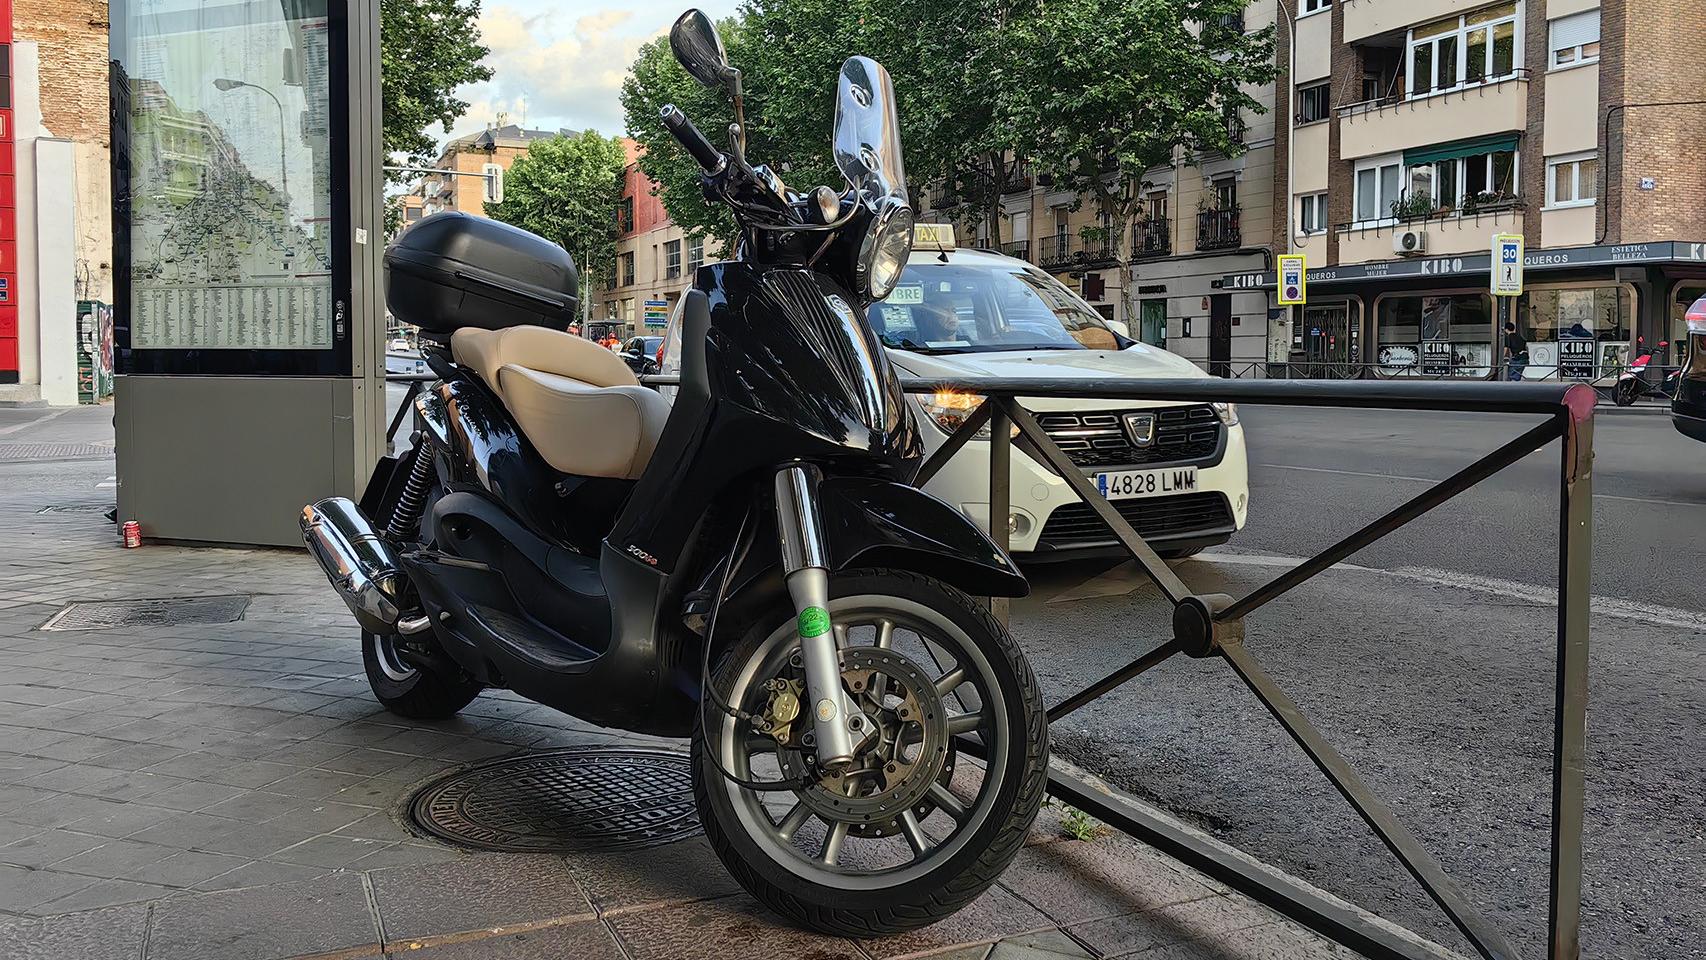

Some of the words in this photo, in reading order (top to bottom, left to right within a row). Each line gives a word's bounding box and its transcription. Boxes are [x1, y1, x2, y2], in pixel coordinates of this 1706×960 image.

[915, 228, 938, 241] TAXI
[1503, 249, 1516, 259] 30
[1524, 254, 1569, 265] QUEROS
[1612, 252, 1646, 260] BELLEZA
[1364, 263, 1389, 271] HOMBRE
[1421, 258, 1462, 274] KIBO
[1233, 274, 1263, 288] KIBO
[1306, 271, 1336, 281] QUEROS
[892, 288, 920, 299] BRE
[1424, 343, 1450, 353] KIBO
[1561, 342, 1593, 353] KIBO
[1111, 474, 1156, 495] 4828
[1162, 470, 1194, 491] LMM
